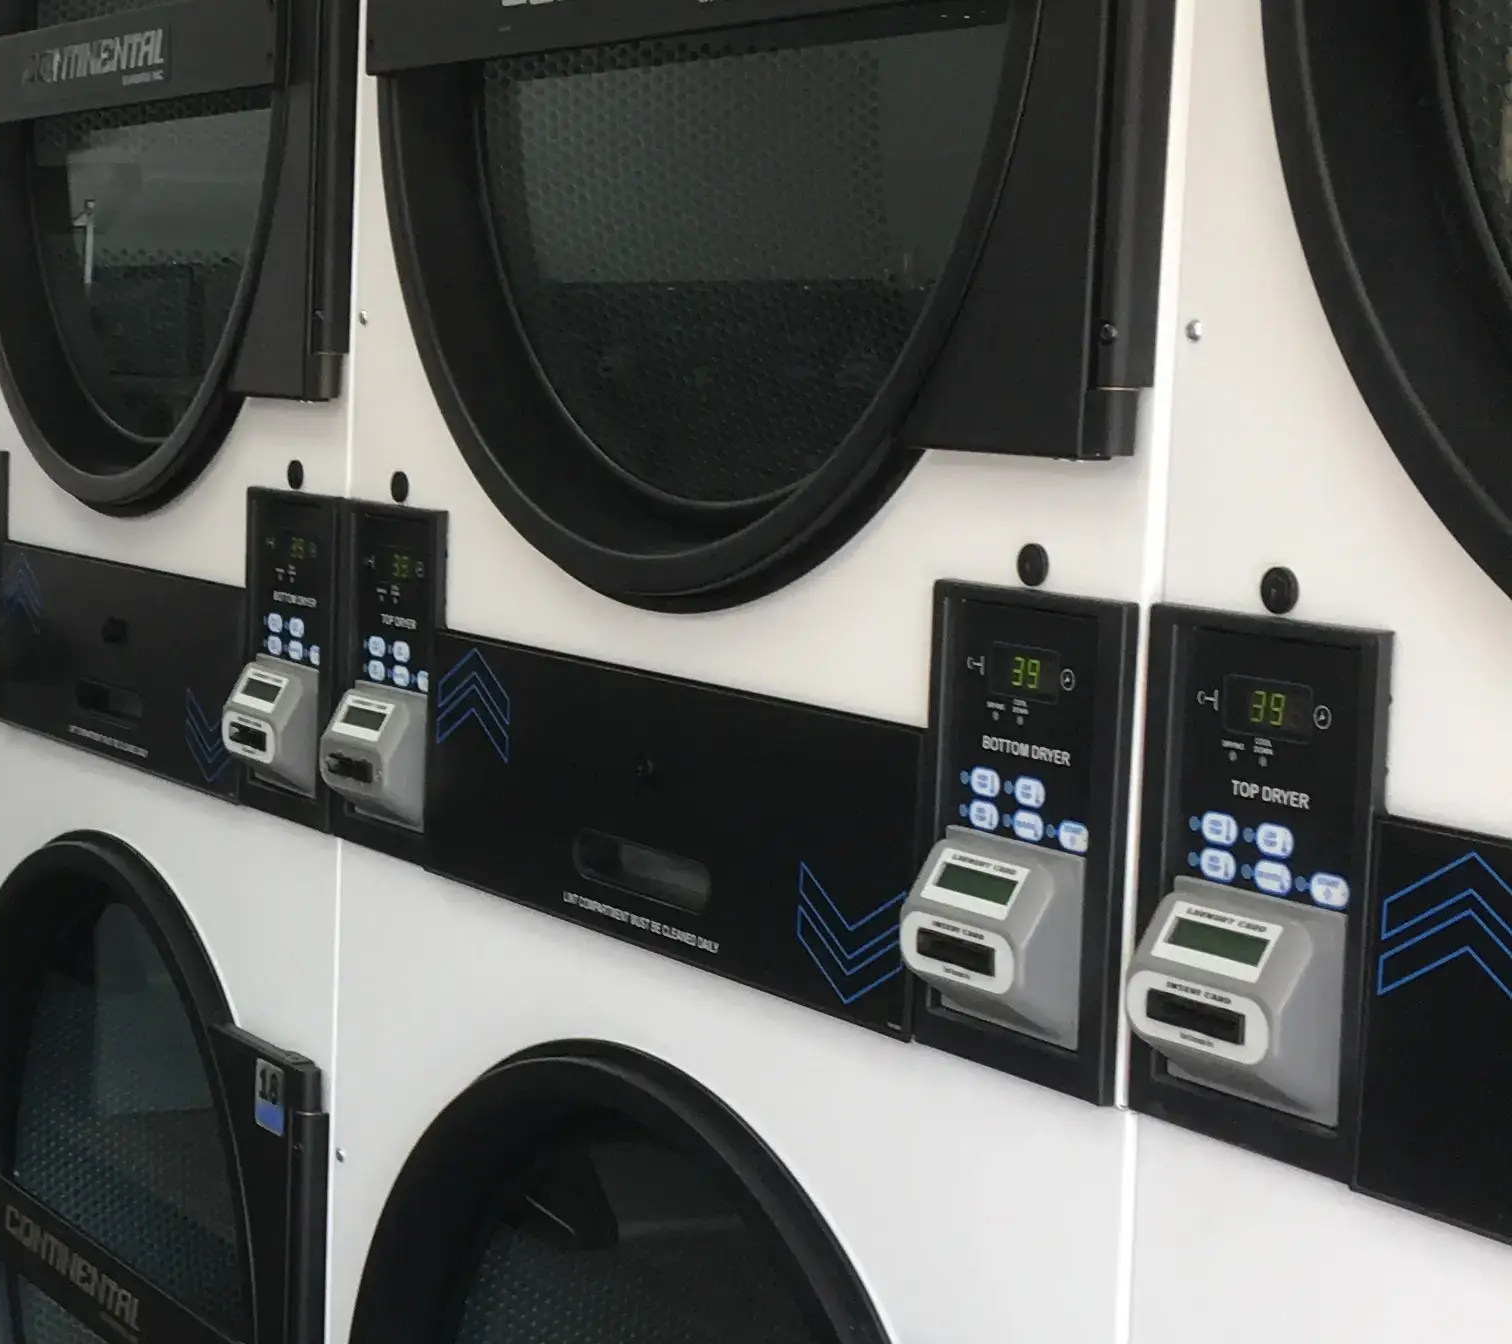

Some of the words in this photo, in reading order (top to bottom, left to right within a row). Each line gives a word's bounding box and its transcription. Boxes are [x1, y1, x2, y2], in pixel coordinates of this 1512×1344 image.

[1011, 656, 1041, 689] 39
[1250, 690, 1286, 726] 39
[982, 735, 1029, 758] BOTTOM
[1031, 743, 1071, 766] DRYER
[1231, 779, 1259, 799] TOP
[1262, 786, 1310, 810] DRYER
[5, 1204, 140, 1332] CONTINENTAL
